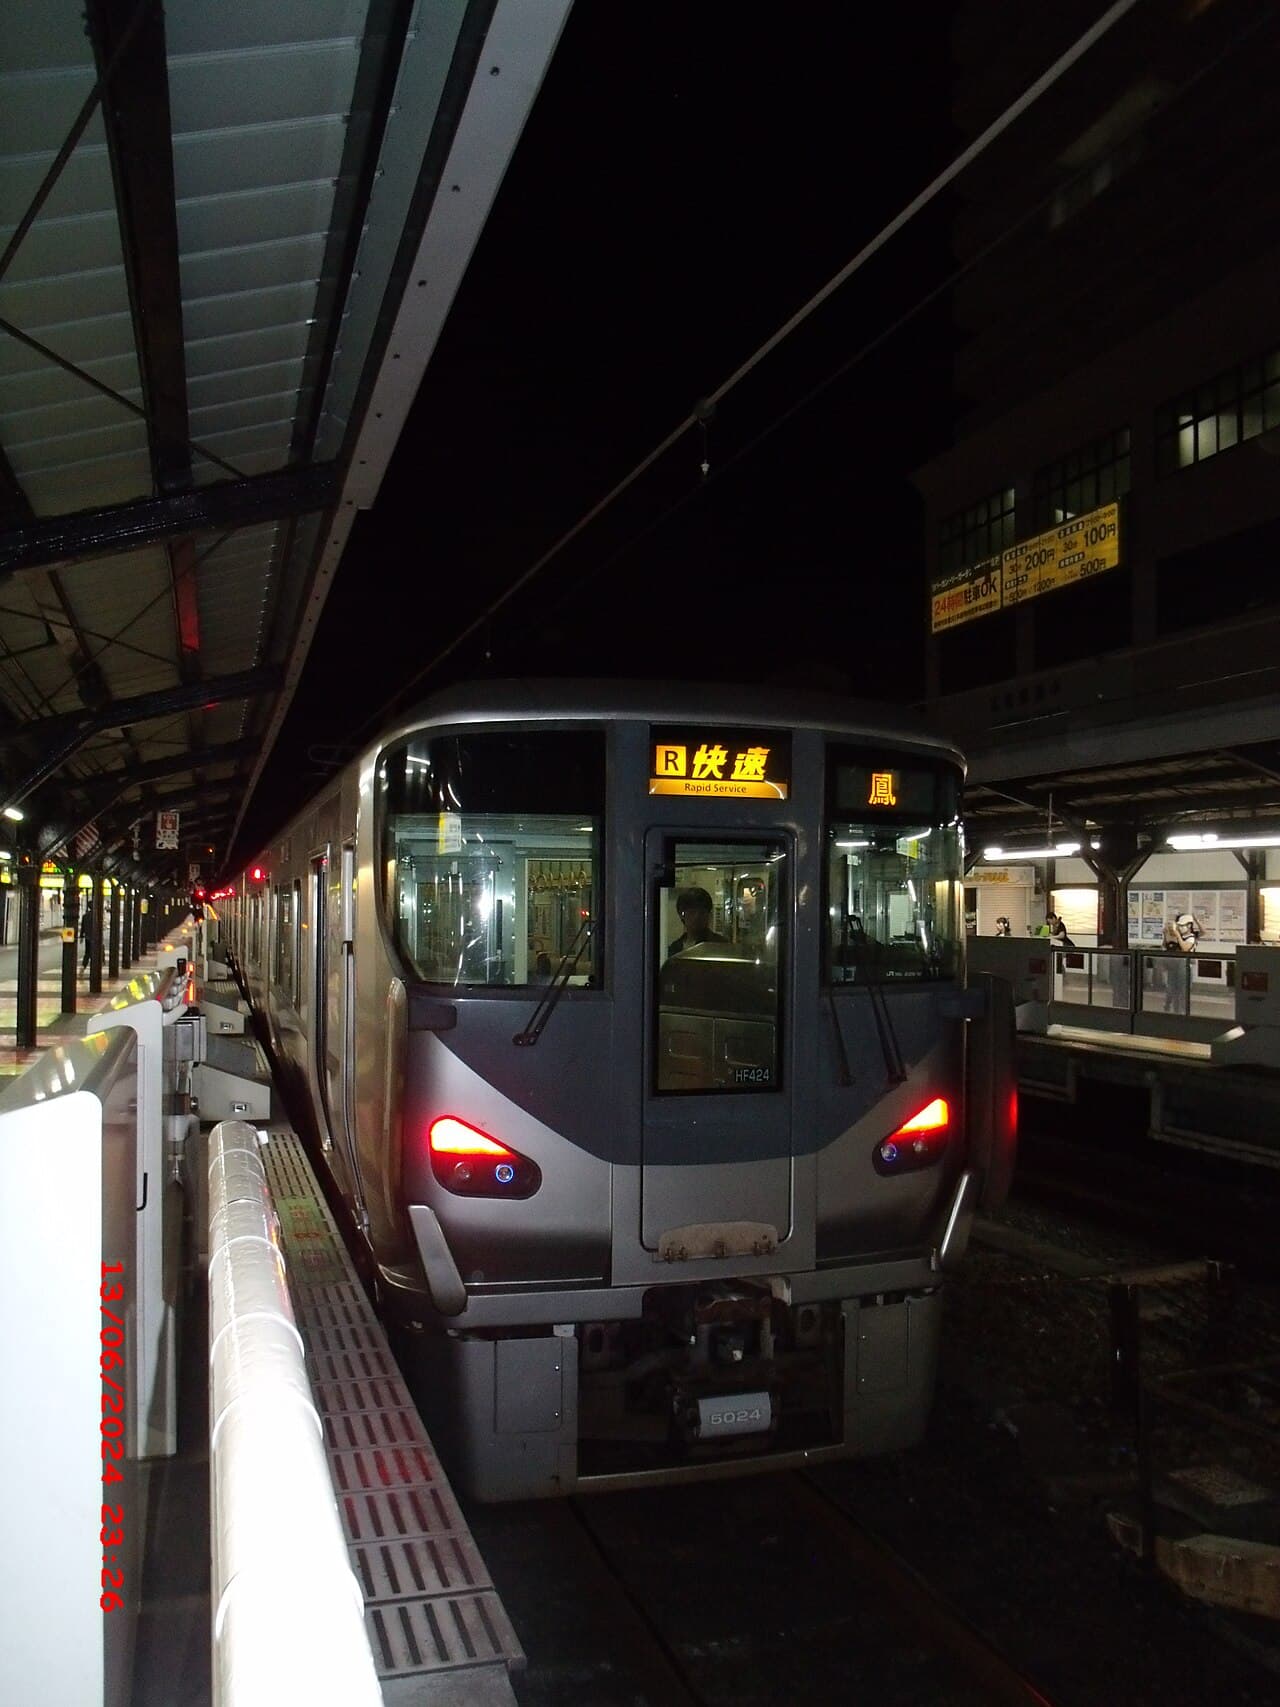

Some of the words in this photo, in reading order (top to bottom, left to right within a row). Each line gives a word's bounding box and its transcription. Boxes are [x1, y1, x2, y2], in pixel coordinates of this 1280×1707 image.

[1084, 523, 1116, 548] 100円
[1025, 548, 1055, 571] 200円
[664, 751, 680, 772] R
[691, 744, 771, 782] 快速
[684, 783, 711, 794] Rapid
[713, 784, 747, 794] Service
[868, 773, 896, 806] 鳳
[735, 1069, 770, 1082] HF424
[711, 1409, 761, 1425] 5024
